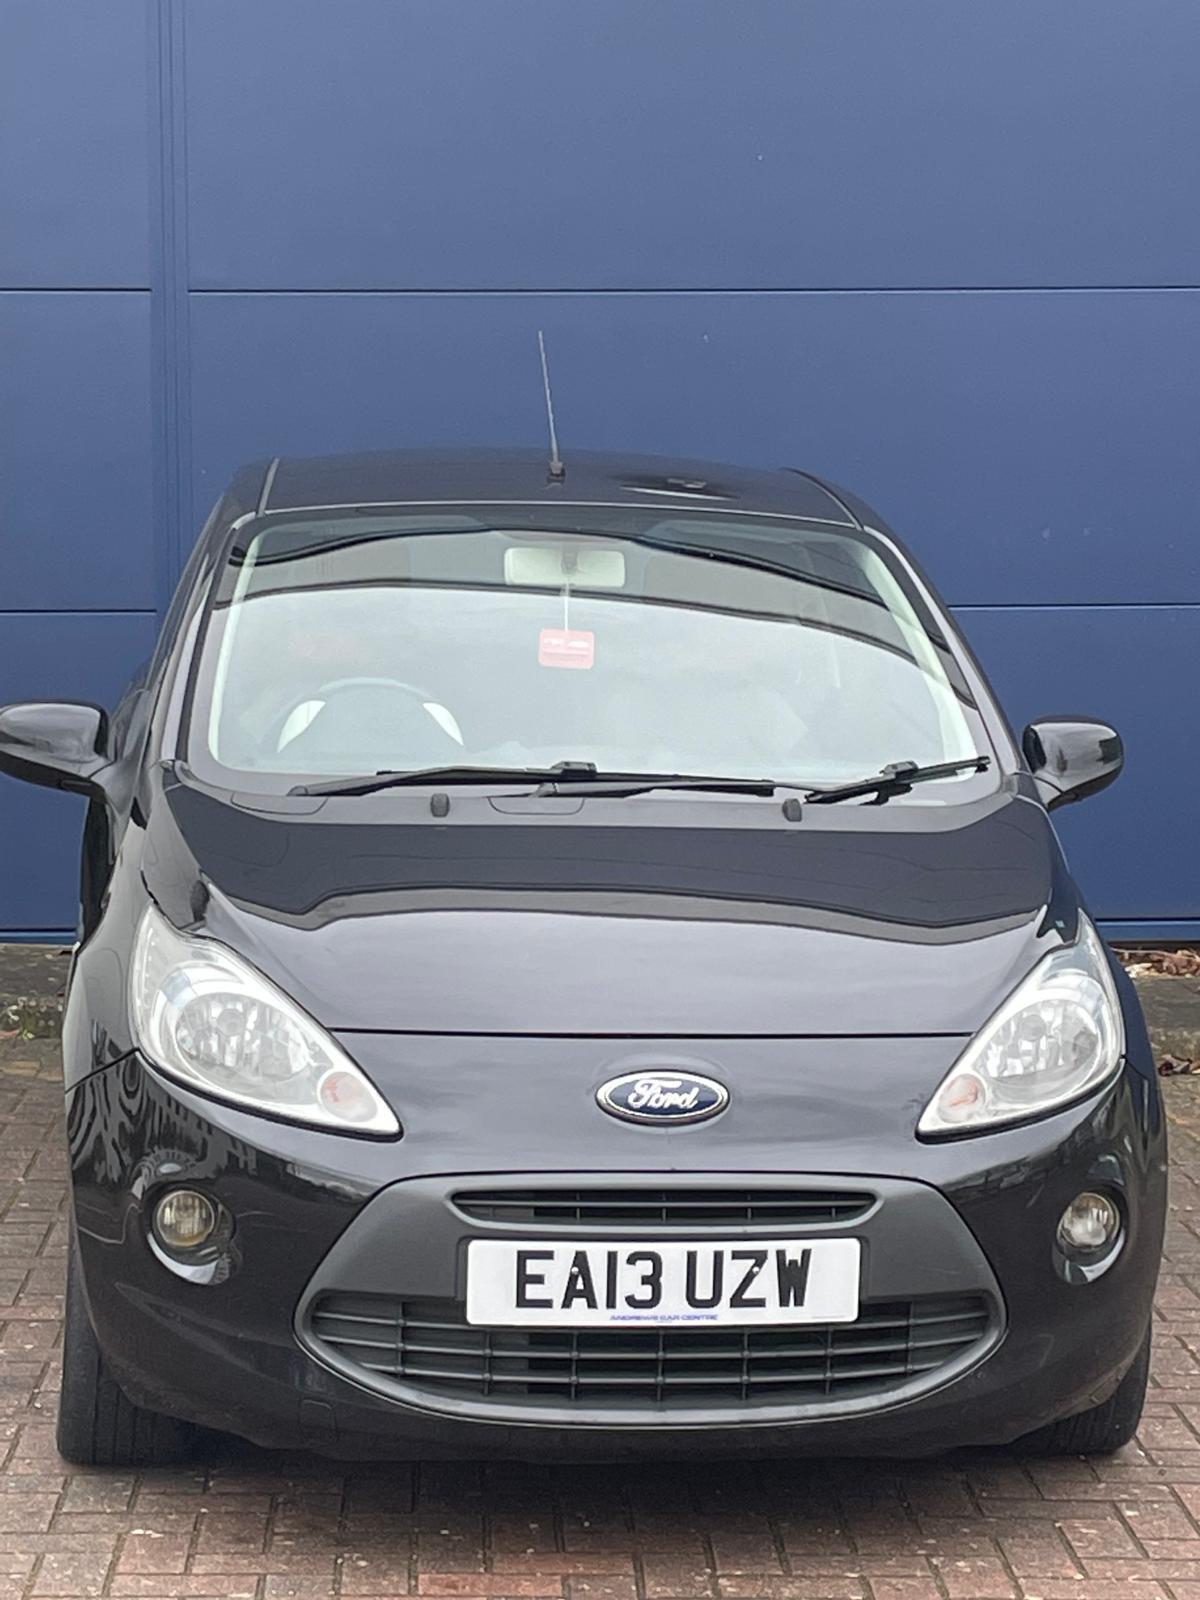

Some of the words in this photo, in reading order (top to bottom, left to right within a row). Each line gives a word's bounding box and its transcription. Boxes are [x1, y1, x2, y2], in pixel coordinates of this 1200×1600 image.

[627, 1078, 699, 1109] Ford
[515, 1249, 663, 1310] EA13
[685, 1248, 812, 1309] UZW
